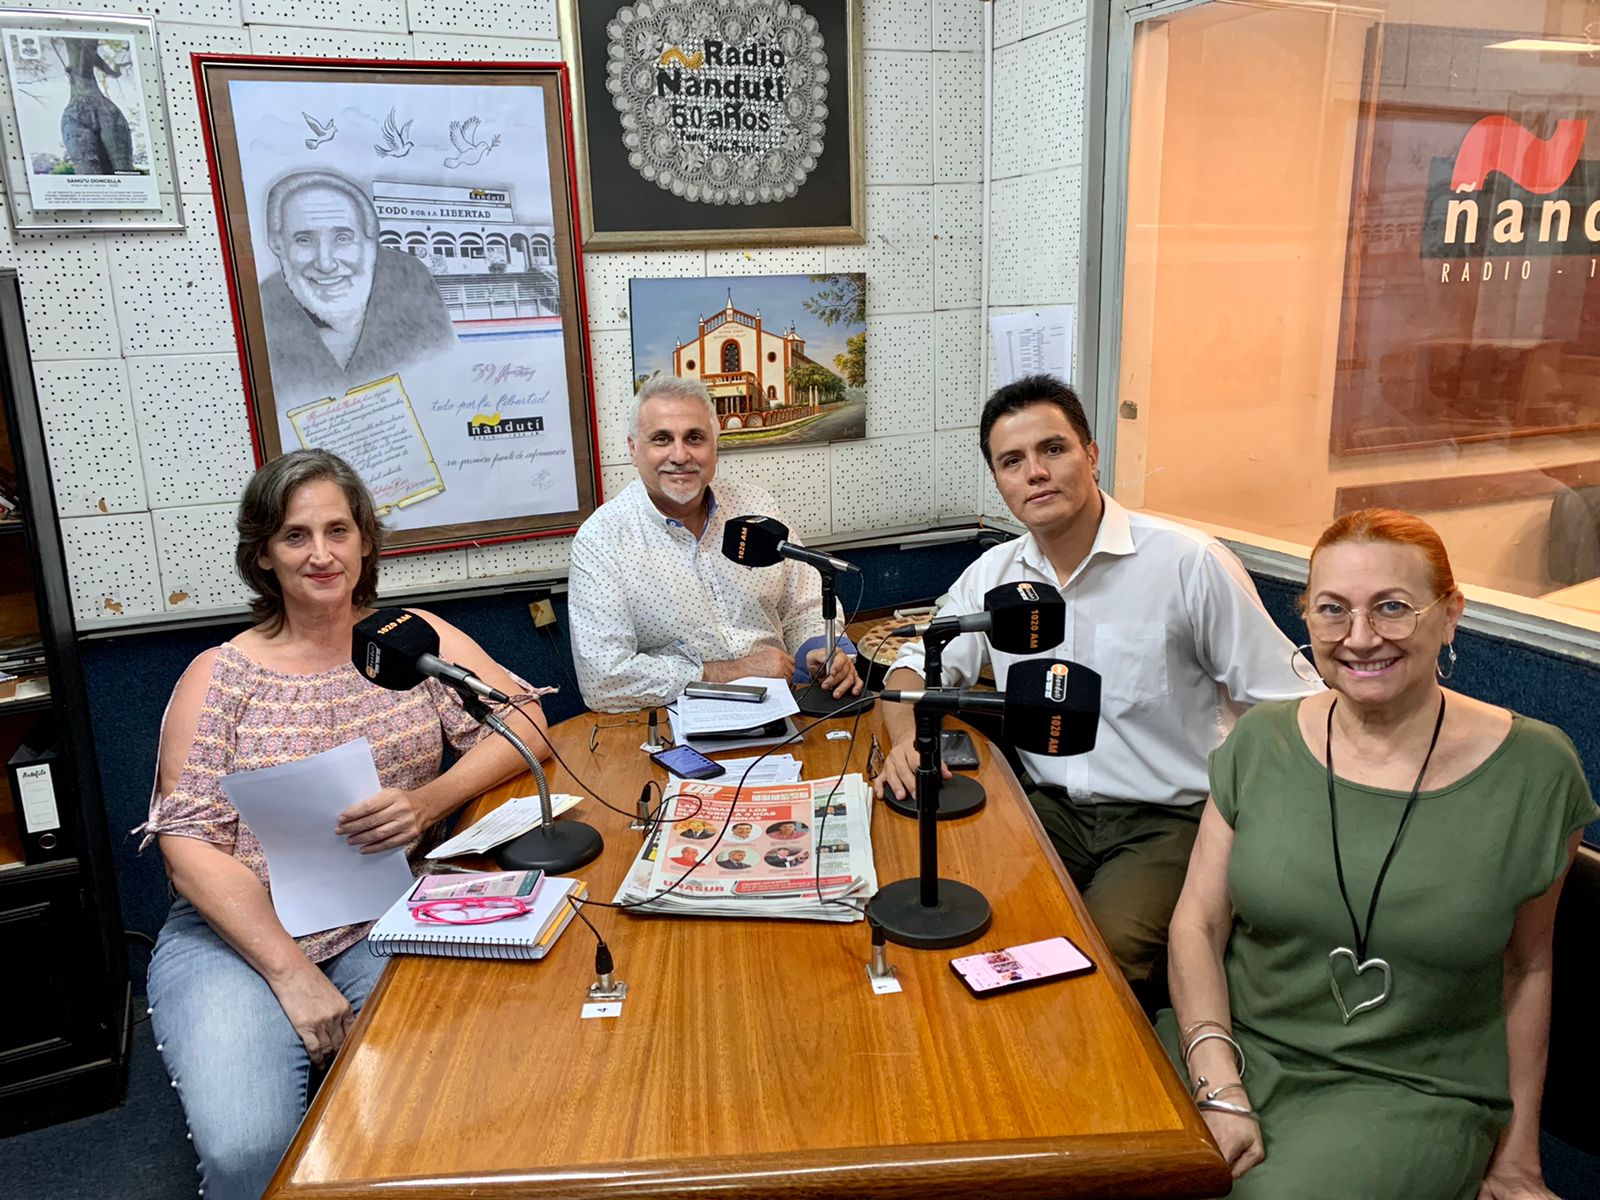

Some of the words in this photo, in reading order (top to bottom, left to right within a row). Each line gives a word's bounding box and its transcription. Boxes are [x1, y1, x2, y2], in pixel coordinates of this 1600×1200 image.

[704, 40, 785, 67] Radio
[672, 104, 701, 129] 50
[706, 101, 770, 132] años
[376, 205, 408, 215] TODO
[440, 208, 491, 219] LIBERTAD
[1441, 260, 1531, 283] RADIO
[431, 398, 454, 411] todo
[496, 391, 550, 412] libertad
[740, 526, 749, 541] AM
[738, 541, 747, 560] 1020
[377, 622, 398, 634] 1020
[396, 614, 412, 624] AM
[1030, 608, 1039, 631] 1020
[1030, 632, 1039, 649] AM
[1050, 714, 1062, 737] 1020
[1048, 737, 1060, 754] AM
